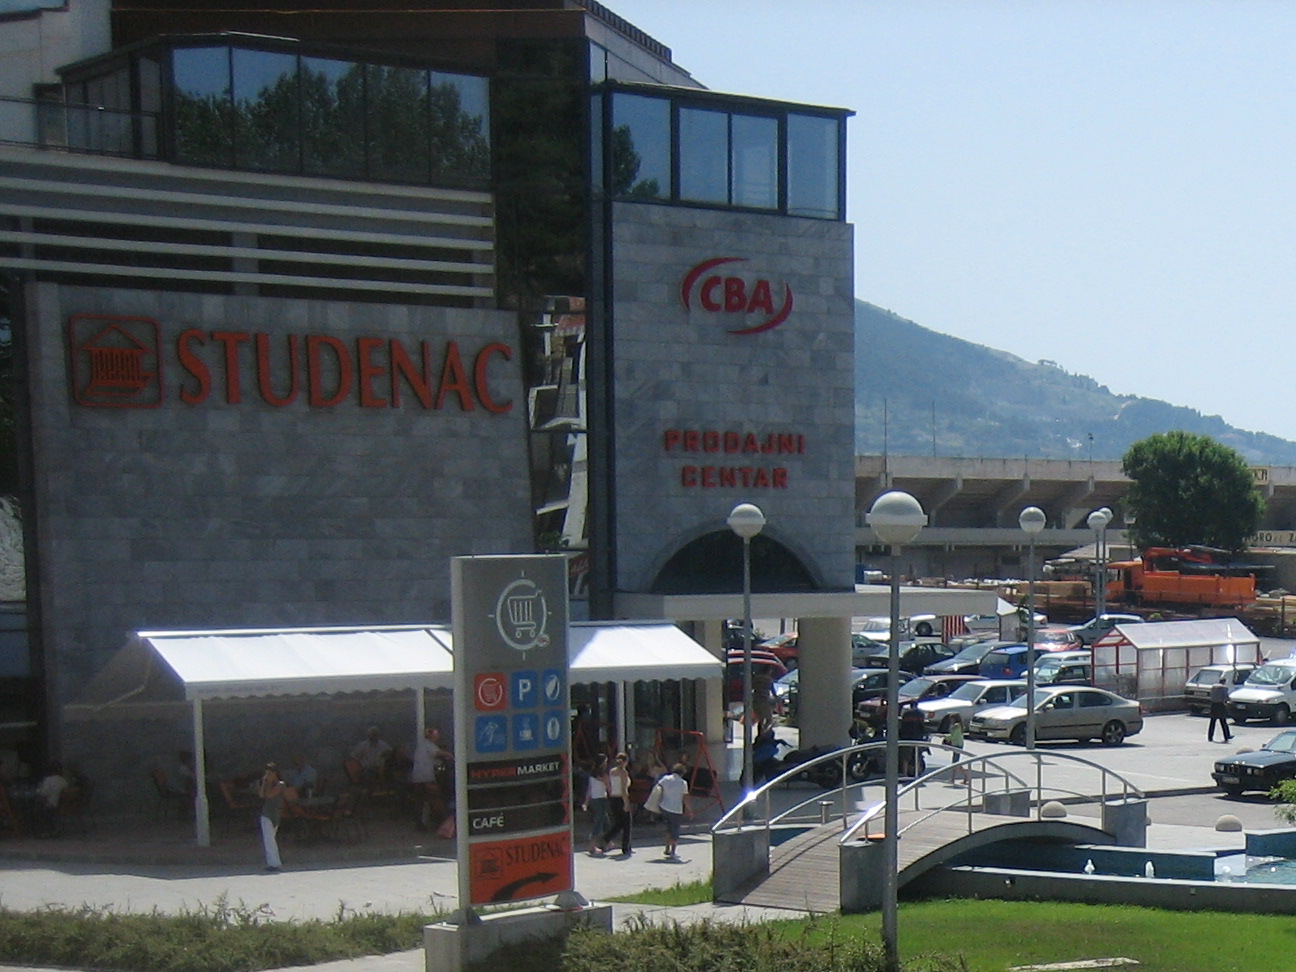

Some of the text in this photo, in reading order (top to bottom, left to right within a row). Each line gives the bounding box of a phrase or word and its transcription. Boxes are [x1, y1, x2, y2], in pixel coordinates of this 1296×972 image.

[700, 276, 774, 314] CBA
[177, 327, 514, 414] STUDENAC
[663, 430, 805, 454] PRODAJNI
[681, 466, 789, 489] CENTAR
[519, 679, 532, 701] P
[472, 812, 505, 829] CAFÉ
